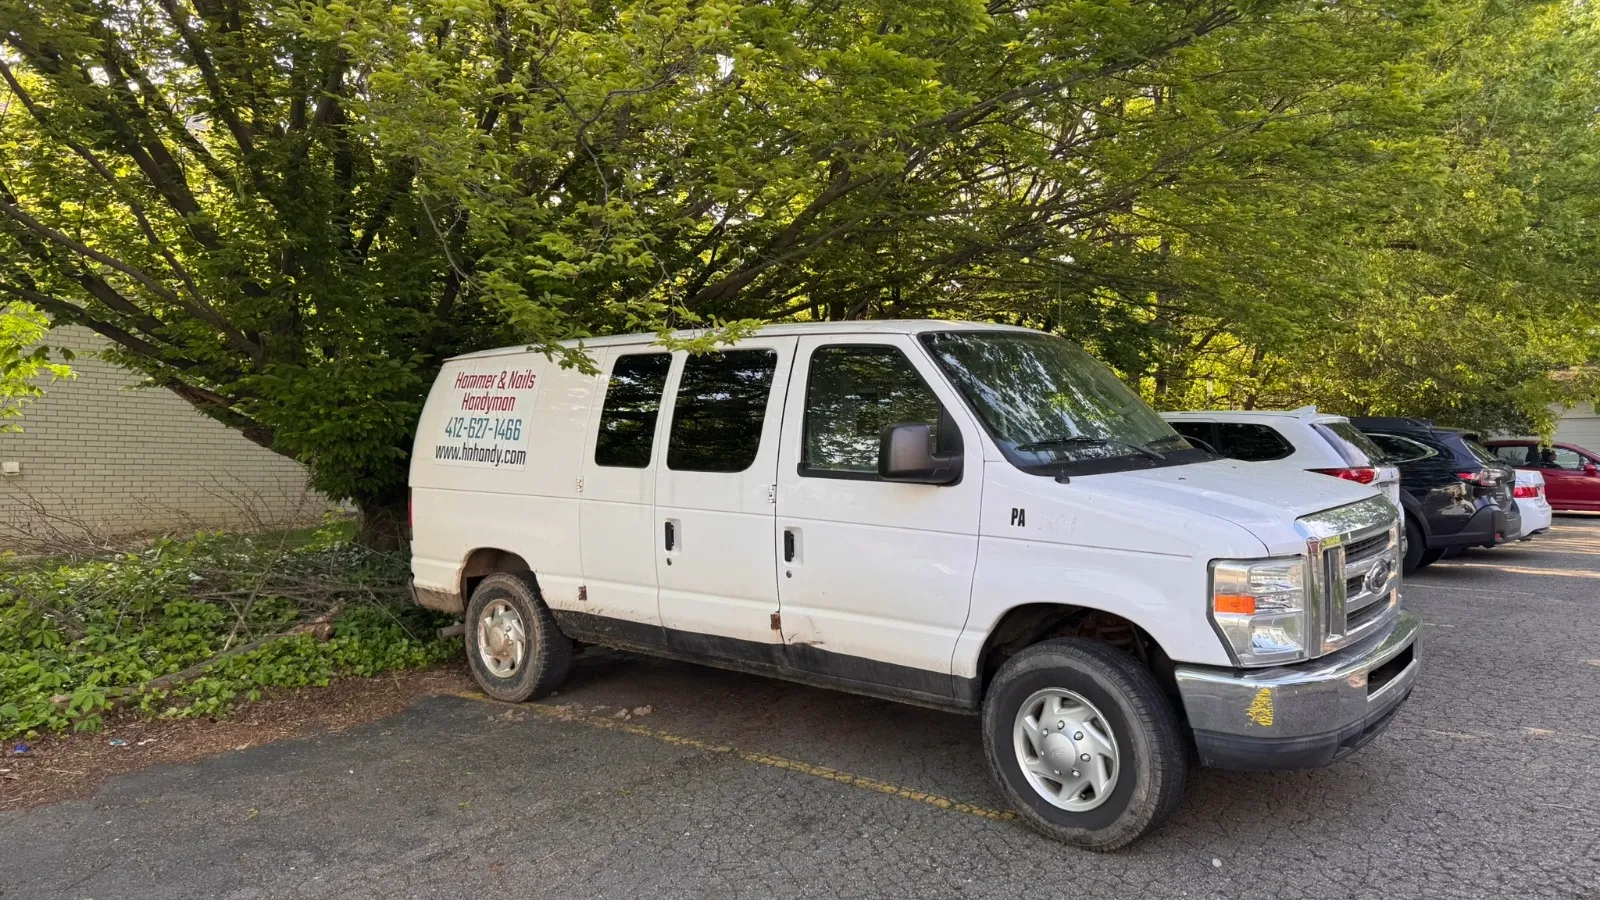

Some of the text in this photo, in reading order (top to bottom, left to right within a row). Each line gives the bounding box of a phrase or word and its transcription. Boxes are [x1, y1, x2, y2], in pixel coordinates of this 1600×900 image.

[454, 369, 536, 390] Hammer & Nails
[461, 391, 516, 415] Handyman
[445, 417, 522, 441] 412-627-1466
[435, 442, 527, 467] www.hnhandy.com
[1010, 507, 1026, 527] PA
